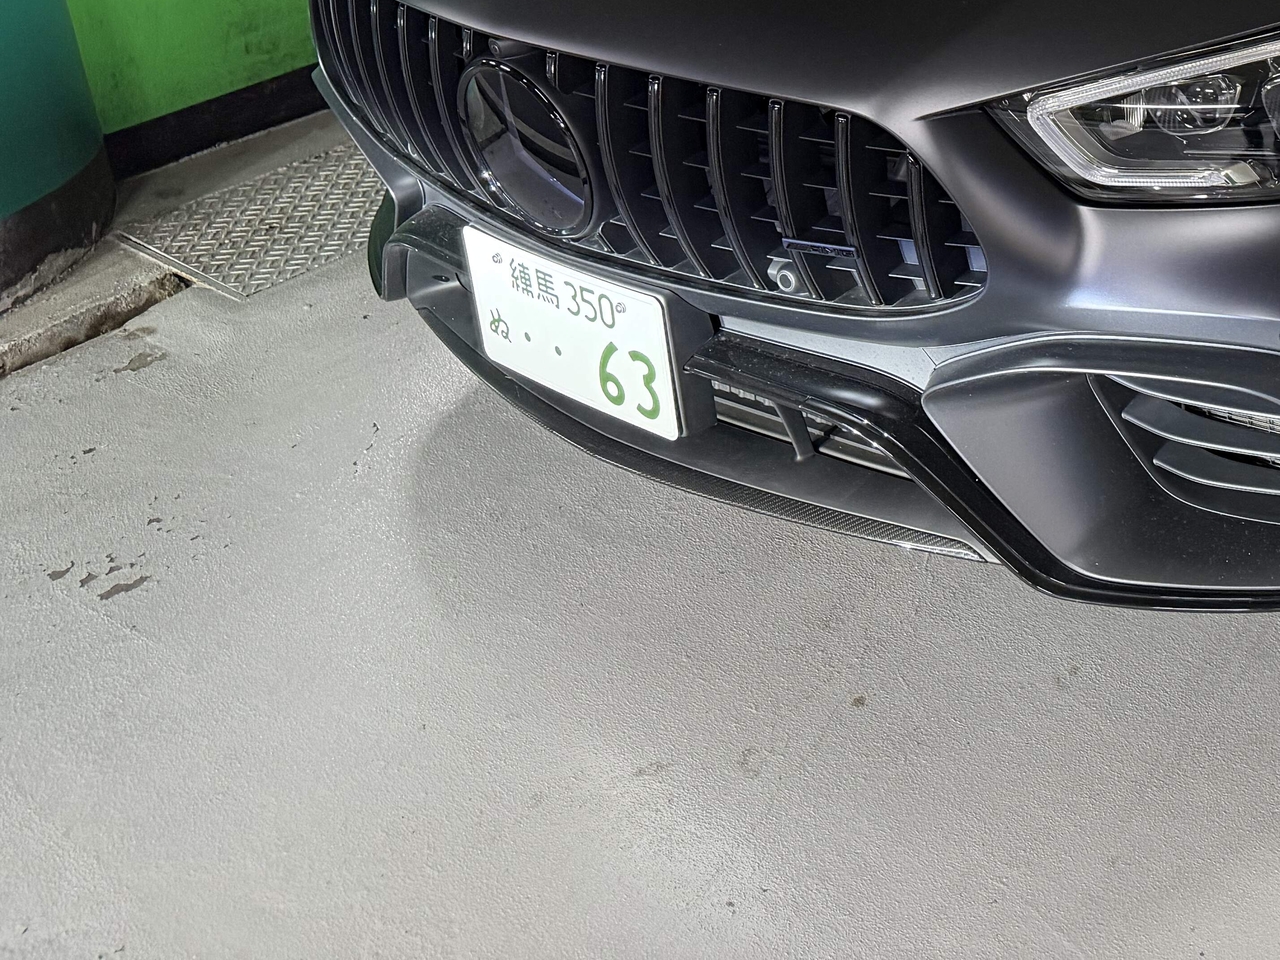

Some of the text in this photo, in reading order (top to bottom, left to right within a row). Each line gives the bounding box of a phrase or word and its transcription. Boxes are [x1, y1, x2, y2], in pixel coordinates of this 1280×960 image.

[509, 258, 616, 329] 練馬 350
[489, 308, 661, 420] ぬ 63
